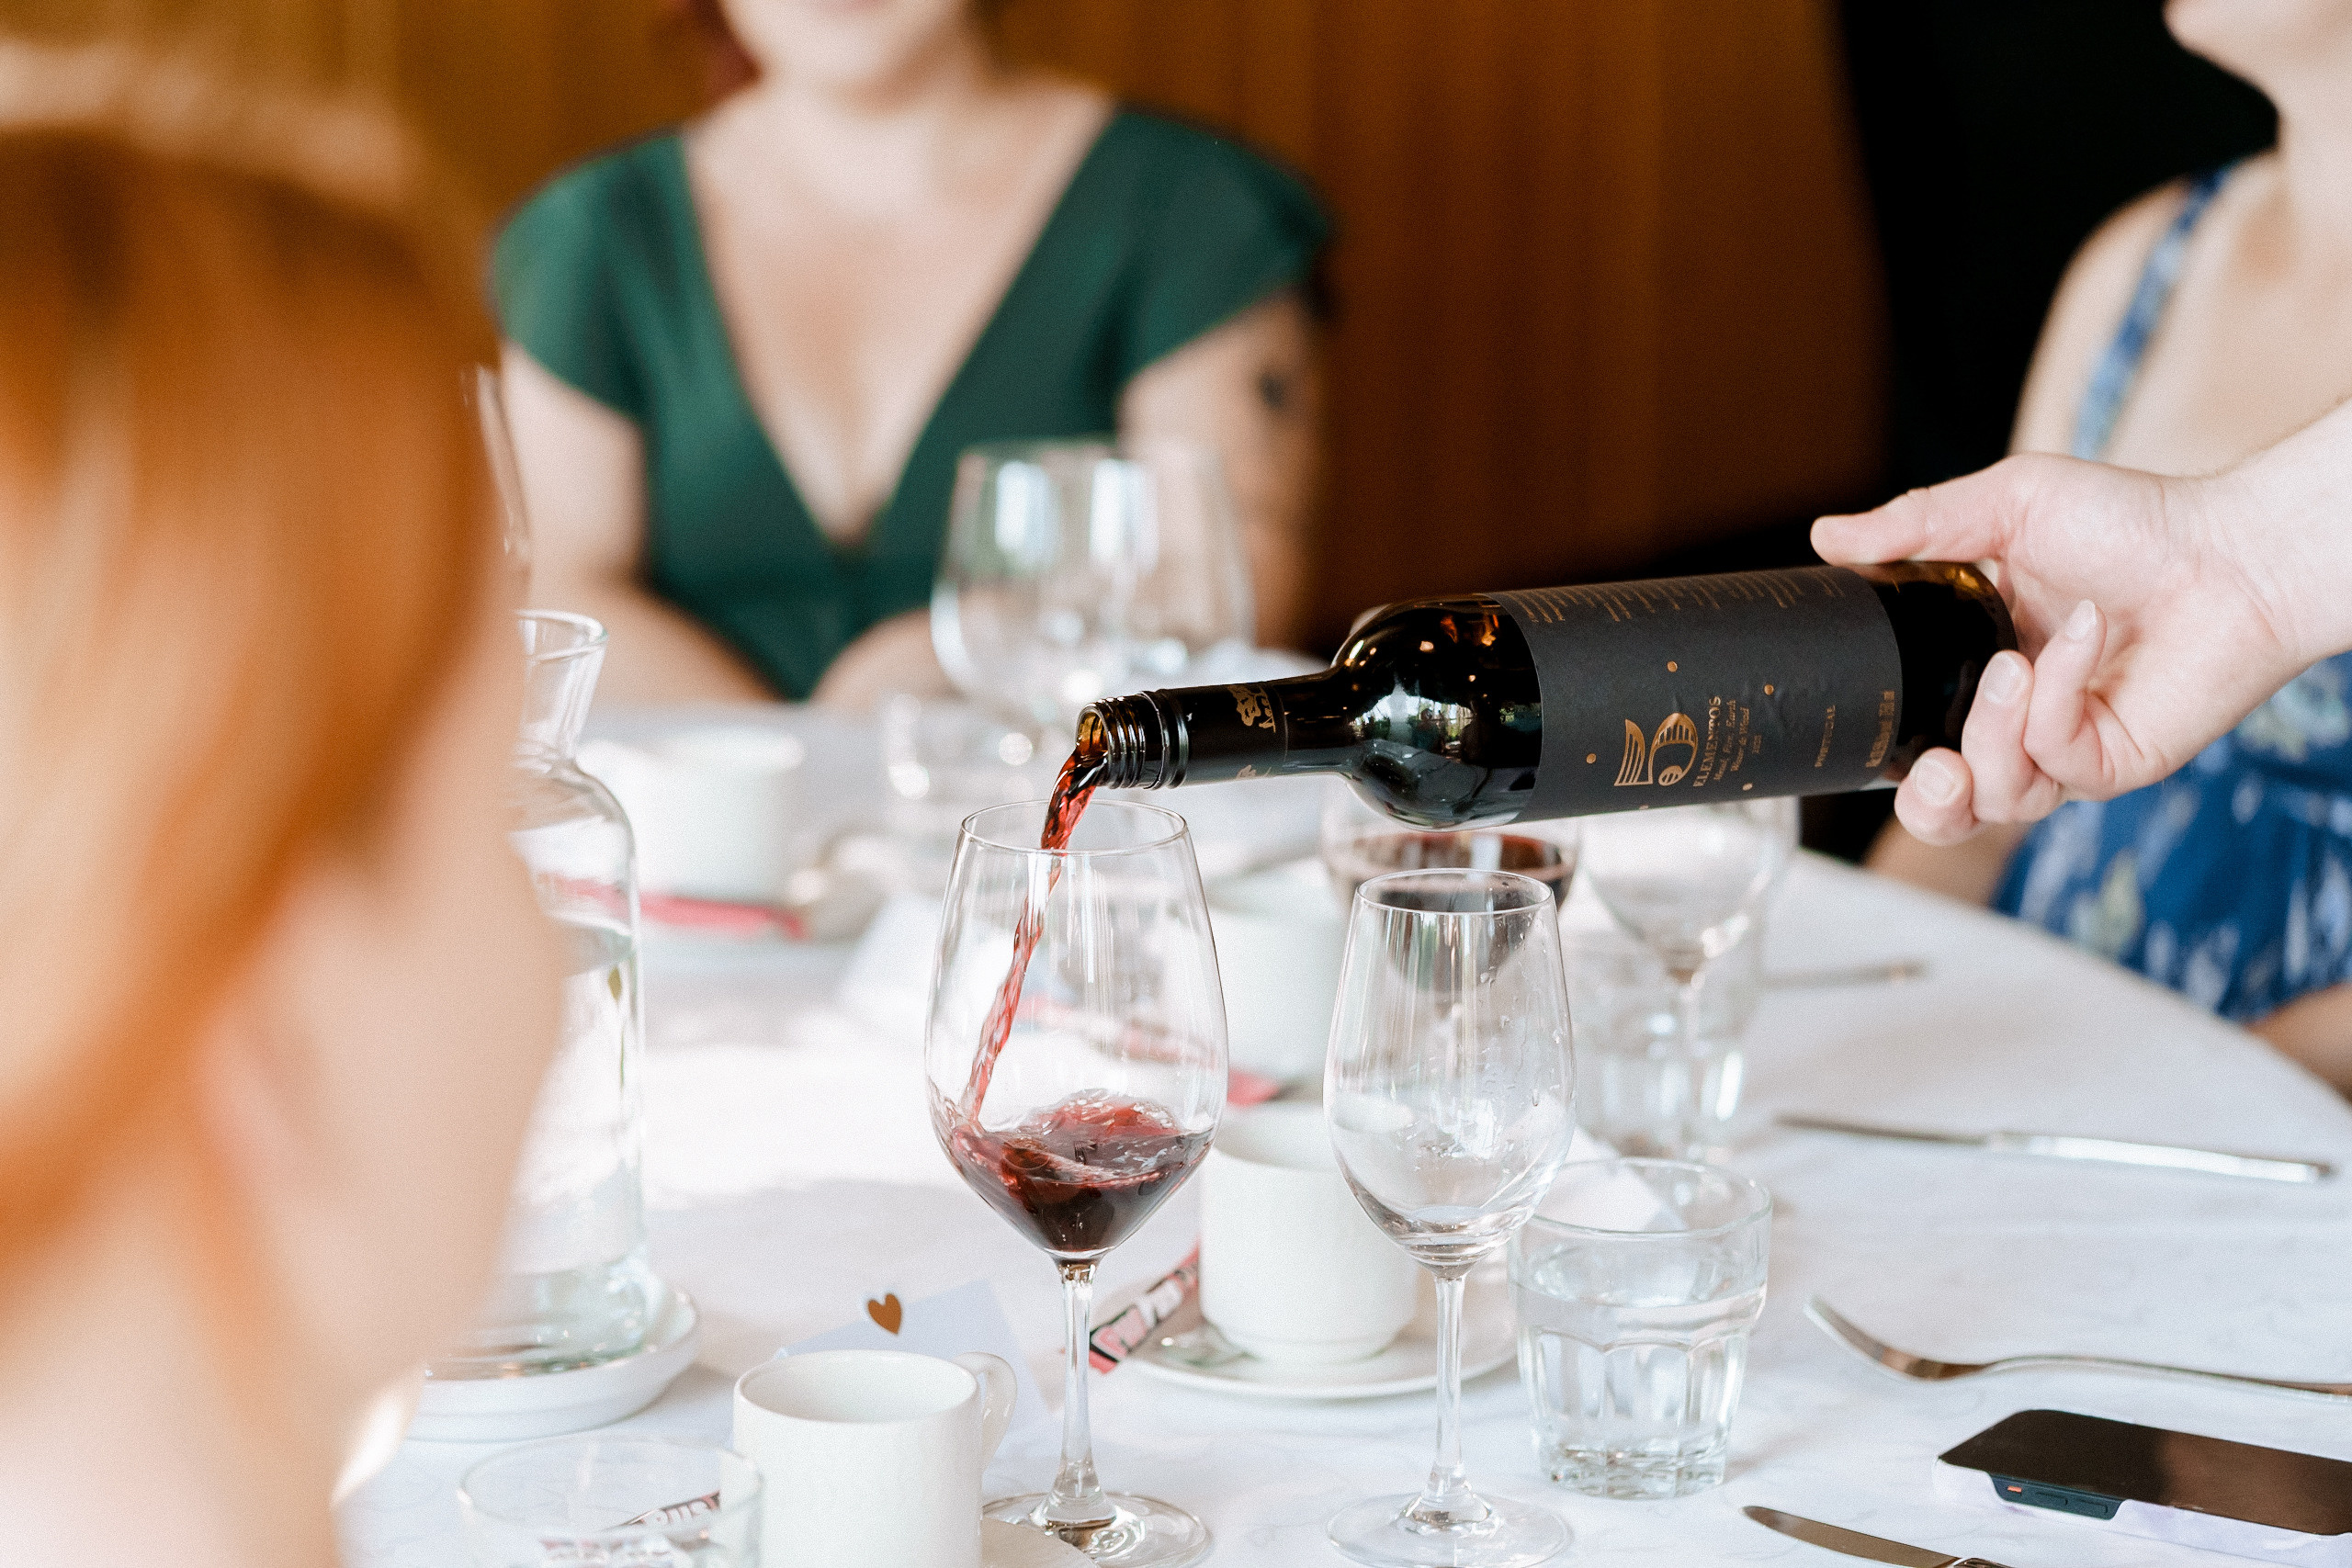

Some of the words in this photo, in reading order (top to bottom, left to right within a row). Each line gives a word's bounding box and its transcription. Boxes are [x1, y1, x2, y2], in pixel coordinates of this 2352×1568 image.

[1693, 696, 1721, 786] ELEMENTOS
[1726, 700, 1736, 728] Earth
[1739, 706, 1749, 735] Wood
[1815, 705, 1836, 767] PORTUGAL
[1614, 712, 1698, 786] 5
